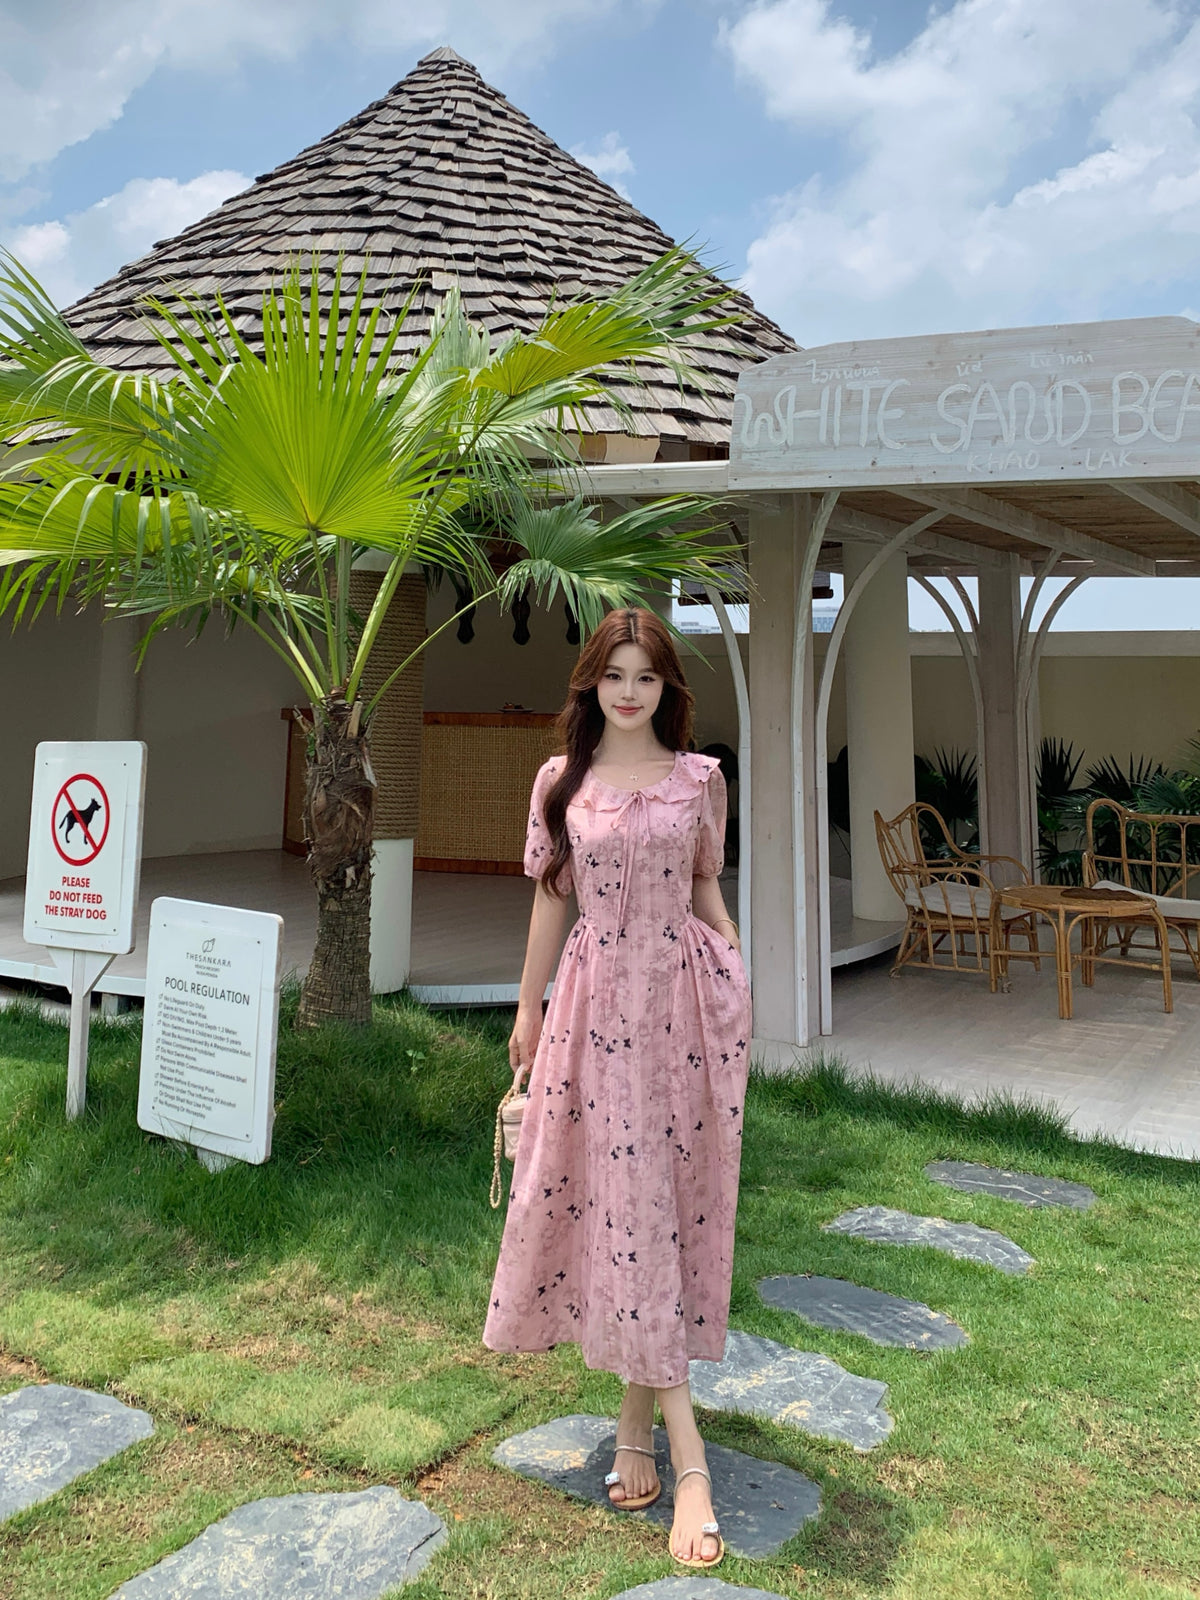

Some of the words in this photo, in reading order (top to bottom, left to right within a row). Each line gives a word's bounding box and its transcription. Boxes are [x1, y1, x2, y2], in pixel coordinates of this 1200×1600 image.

[734, 379, 910, 449] WHITE
[930, 379, 1091, 453] SAND
[966, 451, 1041, 473] KHAO
[1085, 448, 1132, 471] LAK
[62, 876, 90, 888] PLEASE
[49, 890, 61, 900] DO
[63, 892, 80, 902] NOT
[83, 893, 102, 904] FEED
[45, 905, 58, 915] THE
[60, 906, 84, 918] STRAY
[86, 909, 106, 920] DOG
[165, 977, 188, 992] POOL
[191, 982, 250, 1005] REGULATION
